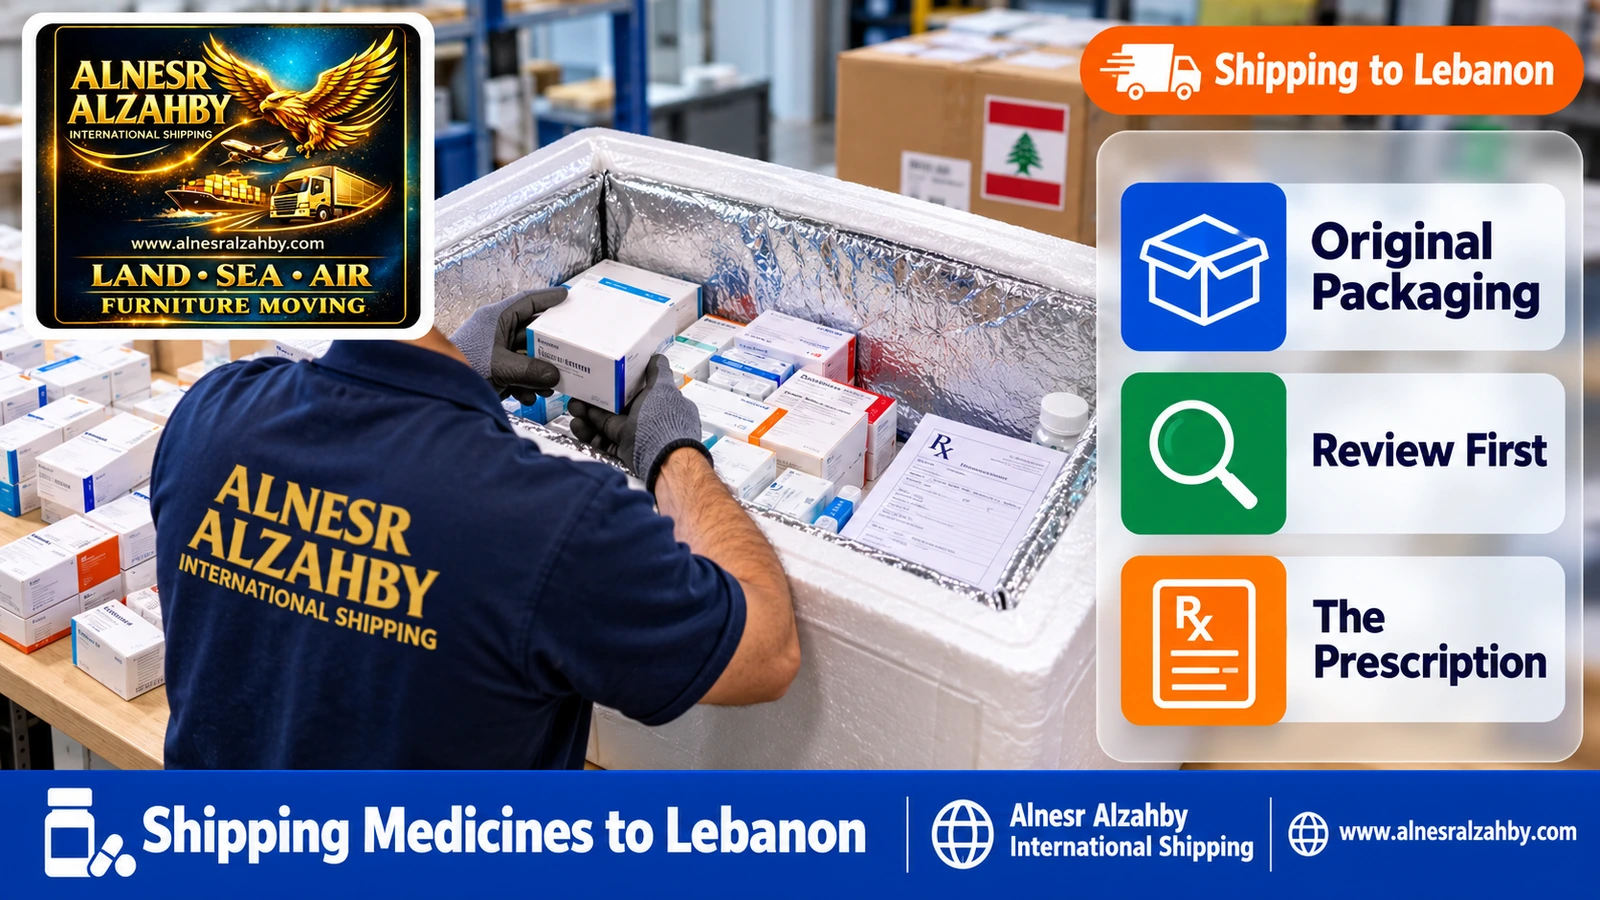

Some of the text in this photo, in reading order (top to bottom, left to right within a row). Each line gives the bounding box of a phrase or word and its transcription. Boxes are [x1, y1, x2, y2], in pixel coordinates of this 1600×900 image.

[928, 433, 954, 461] Rx
[214, 464, 412, 557] ALNESR
[178, 553, 438, 650] INTERNATIONAL SHIPPING
[187, 507, 440, 619] ALZAHBY
